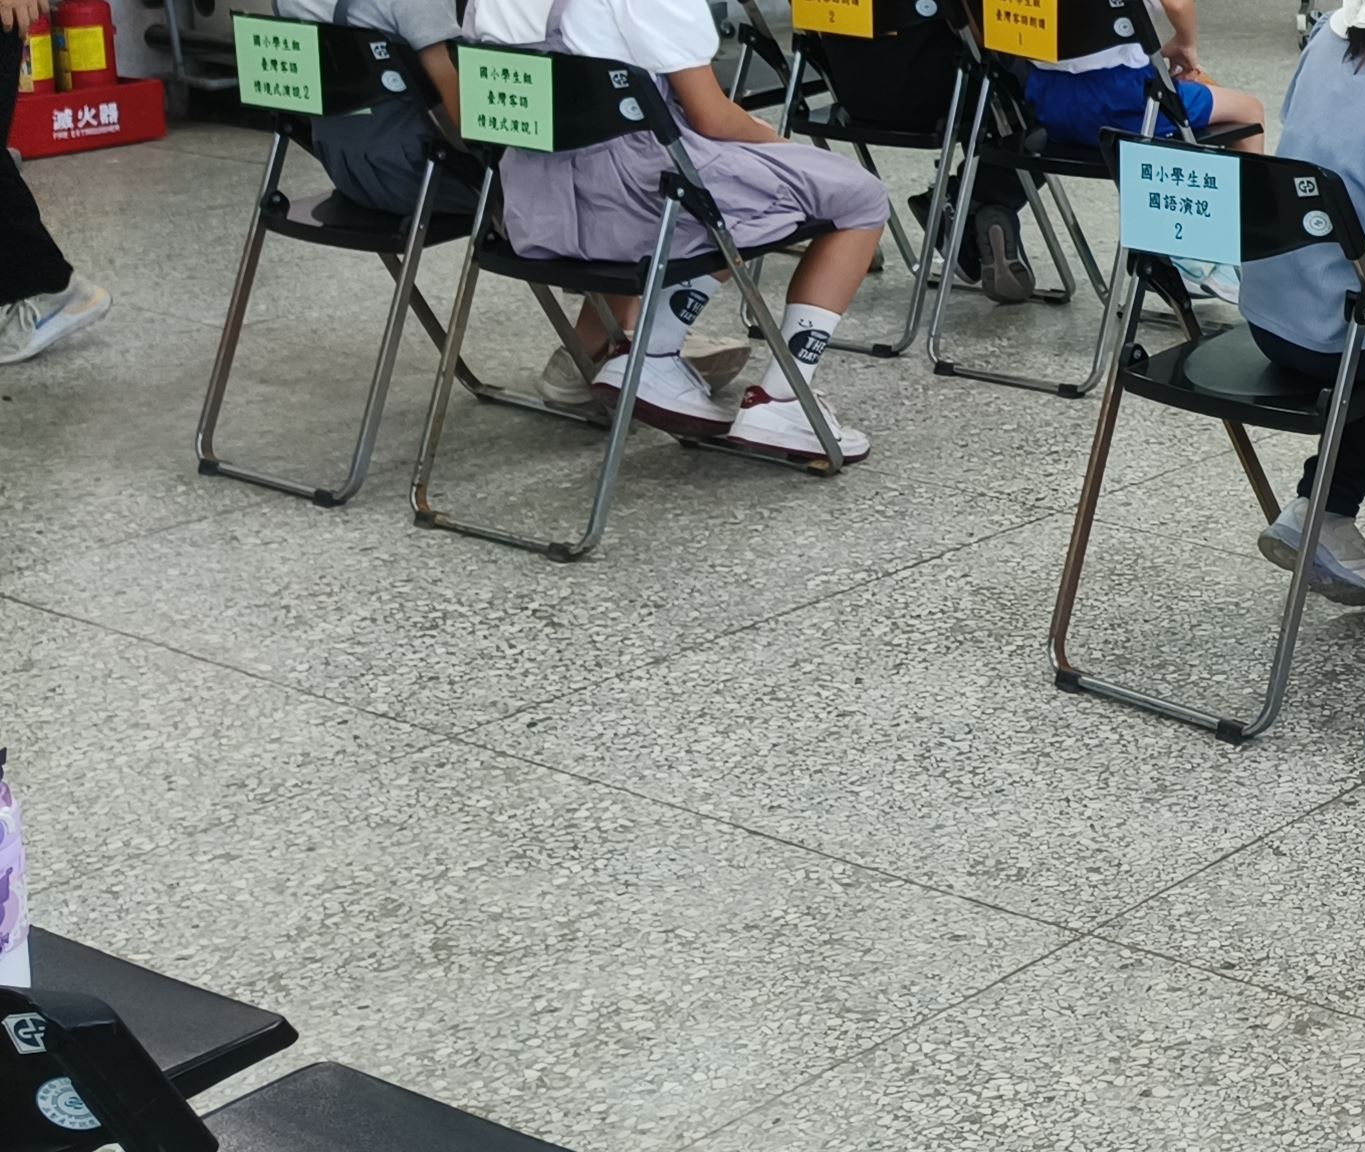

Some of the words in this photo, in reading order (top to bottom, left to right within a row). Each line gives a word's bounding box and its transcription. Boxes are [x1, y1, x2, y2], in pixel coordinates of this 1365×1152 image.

[828, 10, 836, 23] 2
[1018, 31, 1023, 46] 1
[479, 66, 533, 85] 國小學生組
[53, 102, 118, 130] 滅火器
[1141, 163, 1218, 190] 國小學生組
[1149, 193, 1211, 218] 國語演說
[1174, 222, 1183, 240] 2
